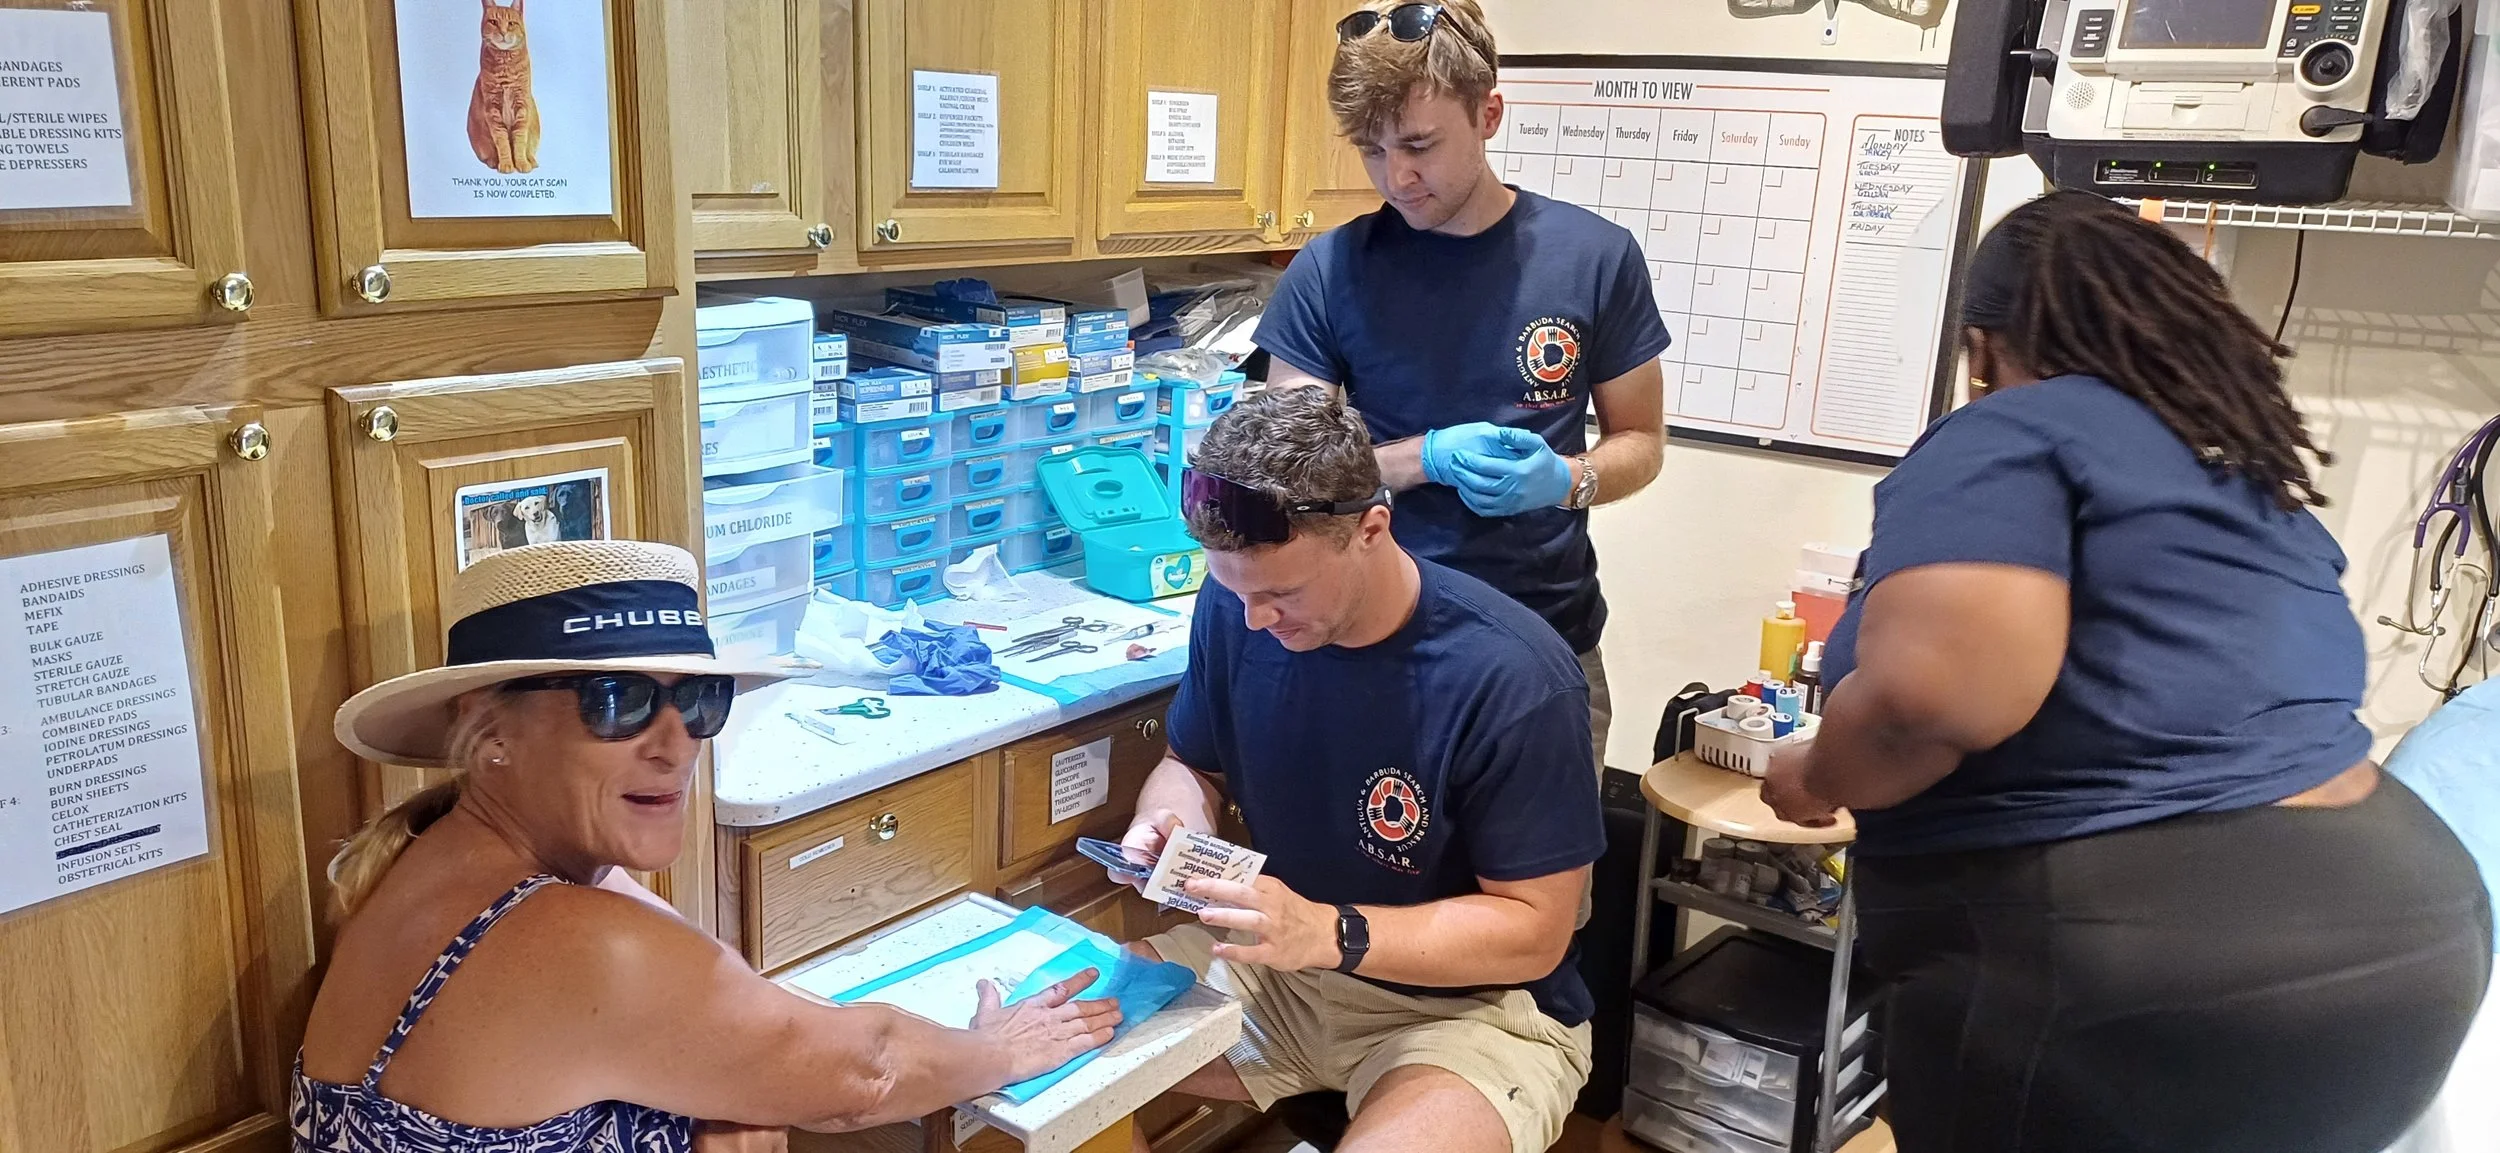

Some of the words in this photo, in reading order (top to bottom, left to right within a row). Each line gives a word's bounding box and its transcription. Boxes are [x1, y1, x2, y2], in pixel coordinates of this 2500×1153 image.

[48, 78, 80, 88] PADS
[1594, 80, 1638, 98] MONTH
[1642, 82, 1658, 99] TO
[1662, 82, 1693, 100] VIEW
[67, 113, 108, 124] WIPES
[30, 129, 91, 139] DRESSING
[94, 128, 122, 138] KITS
[1519, 123, 1548, 138] Tuesday
[1562, 125, 1604, 140] Wednesday
[1616, 127, 1650, 142] Thursday
[1672, 130, 1698, 144] Friday
[1894, 129, 1925, 142] NOTES
[1722, 132, 1758, 147] Saturday
[1779, 134, 1812, 150] Sunday
[16, 144, 70, 154] TOWELS
[10, 159, 88, 170] DEPRESSERS
[1857, 161, 1900, 174] TUESDAY
[452, 178, 482, 186] THANK
[505, 178, 528, 186] YOUR
[529, 178, 544, 186] CAT
[546, 178, 568, 187] SCAN
[2154, 172, 2158, 180] 1
[2206, 174, 2213, 182] 2
[474, 190, 484, 198] IS
[486, 190, 508, 198] NOW
[510, 190, 557, 199] COMPLETED.
[1851, 201, 1898, 214] THURSDAY
[1850, 223, 1884, 235] FRIDAY
[1518, 317, 1554, 342] BARBUDA
[1522, 388, 1569, 402] A.B.S.A.R.
[491, 491, 514, 500] called
[730, 512, 792, 535] CHLORIDE
[20, 576, 81, 594] ADHESIVE
[84, 564, 146, 583] DRESSINGS
[22, 588, 85, 608] BANDAIDS
[24, 606, 63, 622] MEFIX
[563, 609, 703, 634] CHUBB
[26, 622, 58, 636] TAPE
[30, 640, 62, 654] BULK
[65, 631, 104, 647] GAUZE
[32, 652, 72, 668] MASKS
[34, 663, 82, 682] STERILE
[86, 654, 124, 671] GAUZE
[36, 676, 90, 695] STRETCH
[92, 666, 130, 683] GAUZE
[38, 689, 94, 708] TUBULAR
[96, 674, 157, 696] BANDAGES
[40, 702, 113, 726] AMBULANCE
[116, 688, 176, 709] DRESSINGS
[42, 718, 105, 740] COMBINED
[108, 710, 138, 727] PADS
[44, 735, 86, 753] IODINE
[88, 720, 150, 743] DRESSINGS
[46, 740, 126, 766] PETROLATUM
[128, 724, 188, 746] DRESSINGS
[48, 754, 119, 779] UNDERPADS
[1056, 752, 1086, 767] CAUTERIZER
[1055, 761, 1088, 776] GLUCOMETER
[49, 780, 82, 797] BURN
[85, 764, 148, 788] DRESSINGS
[1054, 786, 1070, 796] PULSE
[1070, 777, 1096, 790] OXIMETER
[1055, 772, 1080, 786] OTOSCOPE
[51, 794, 84, 810] BURN
[86, 782, 130, 800] SHEETS
[1054, 788, 1092, 806] THERMOMETER
[1356, 799, 1373, 839] ANTIGUA
[1365, 767, 1401, 786] BARBUDA
[1403, 772, 1428, 804] SEARCH
[1420, 806, 1430, 828] AND
[52, 805, 90, 822] CELOX
[53, 799, 160, 834] CATHETERIZATION
[162, 792, 188, 806] KITS
[54, 830, 92, 848] CHEST
[94, 822, 122, 837] SEAL
[58, 852, 112, 872] INFUSION
[114, 842, 142, 857] SETS
[1190, 844, 1230, 864] Coverlet
[1358, 839, 1415, 868] A.B.S.A.R.
[58, 854, 136, 886] OBSTETRICAL
[138, 848, 164, 862] KITS
